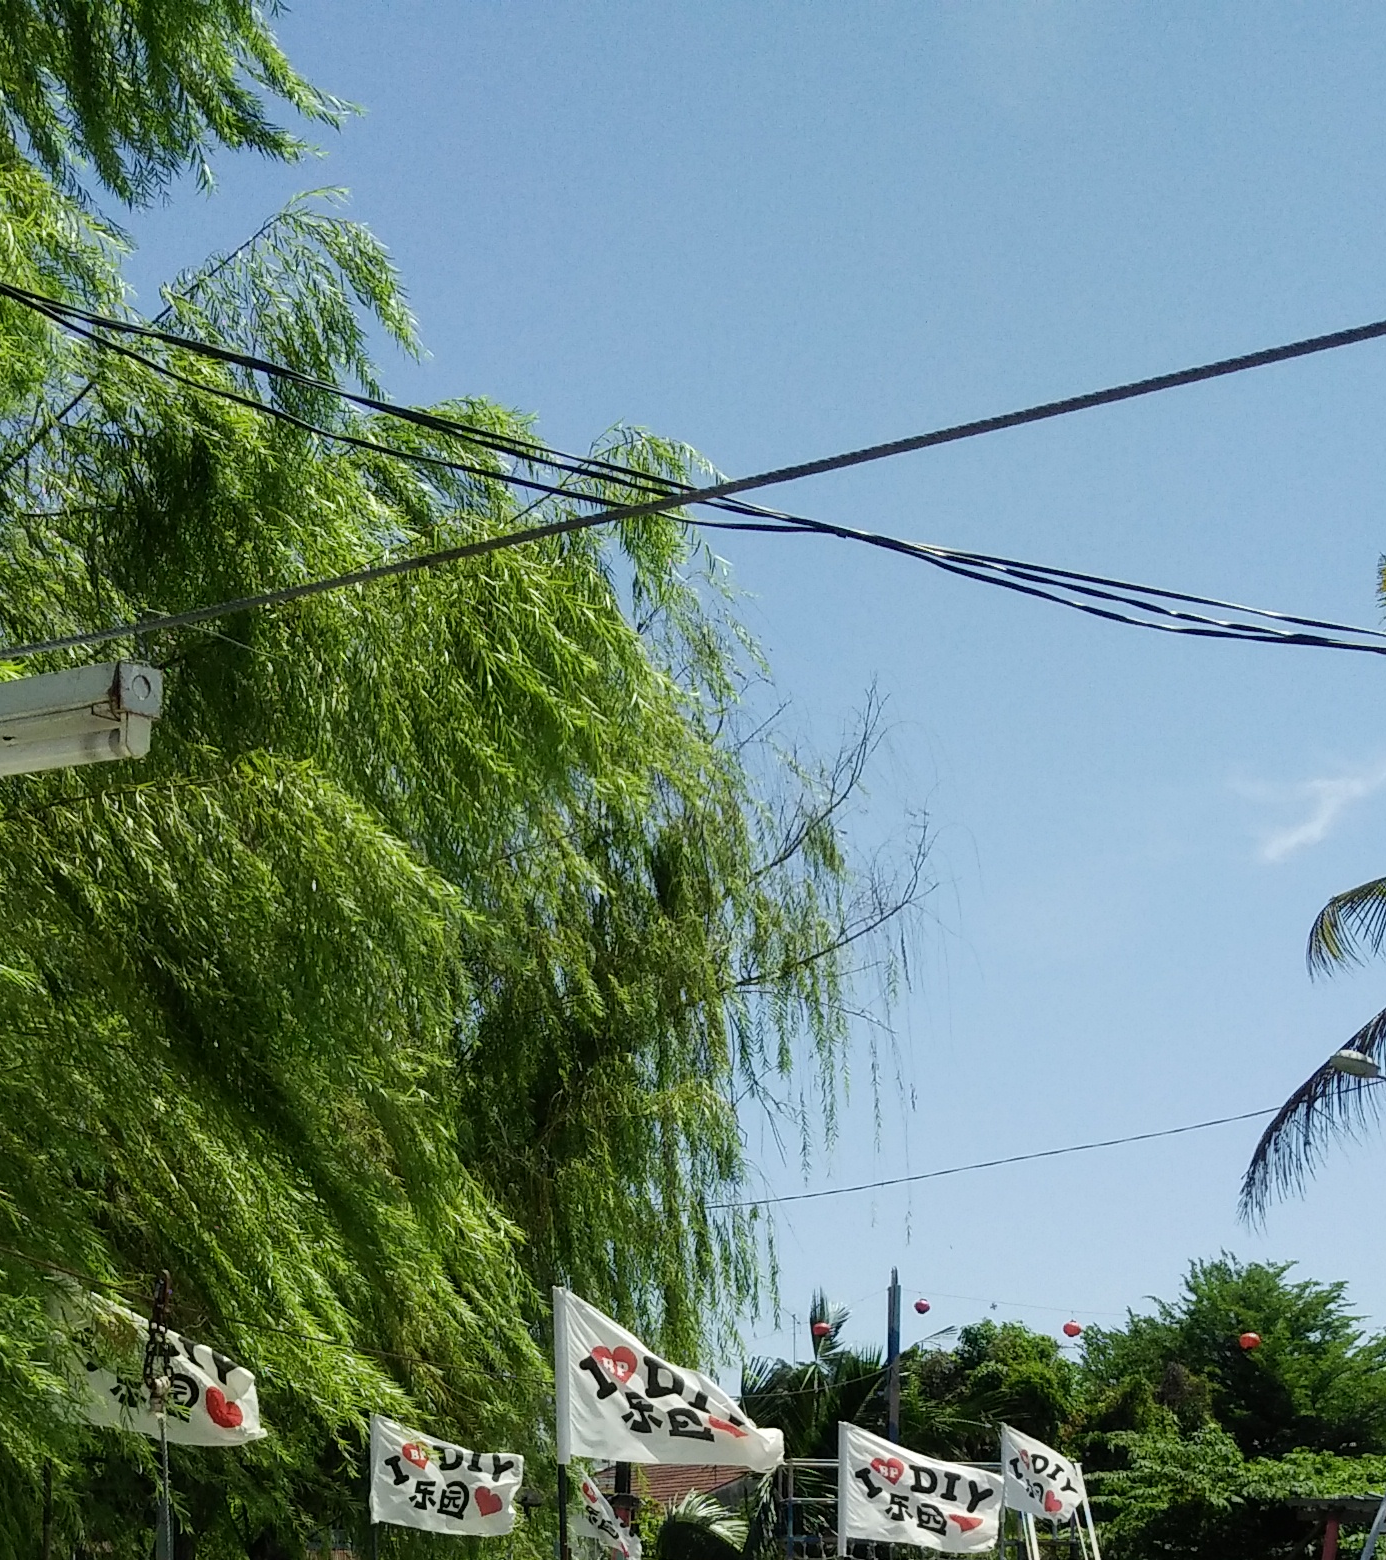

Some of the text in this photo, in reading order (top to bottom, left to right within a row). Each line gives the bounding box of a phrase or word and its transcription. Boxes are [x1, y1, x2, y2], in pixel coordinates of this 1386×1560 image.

[579, 1355, 618, 1399] I
[384, 1455, 409, 1486] I
[432, 1445, 514, 1482] DIY
[1009, 1453, 1079, 1494] I DIY
[408, 1480, 470, 1520] 乐园
[855, 1464, 994, 1513] I BP DIY
[884, 1493, 947, 1536] 乐园
